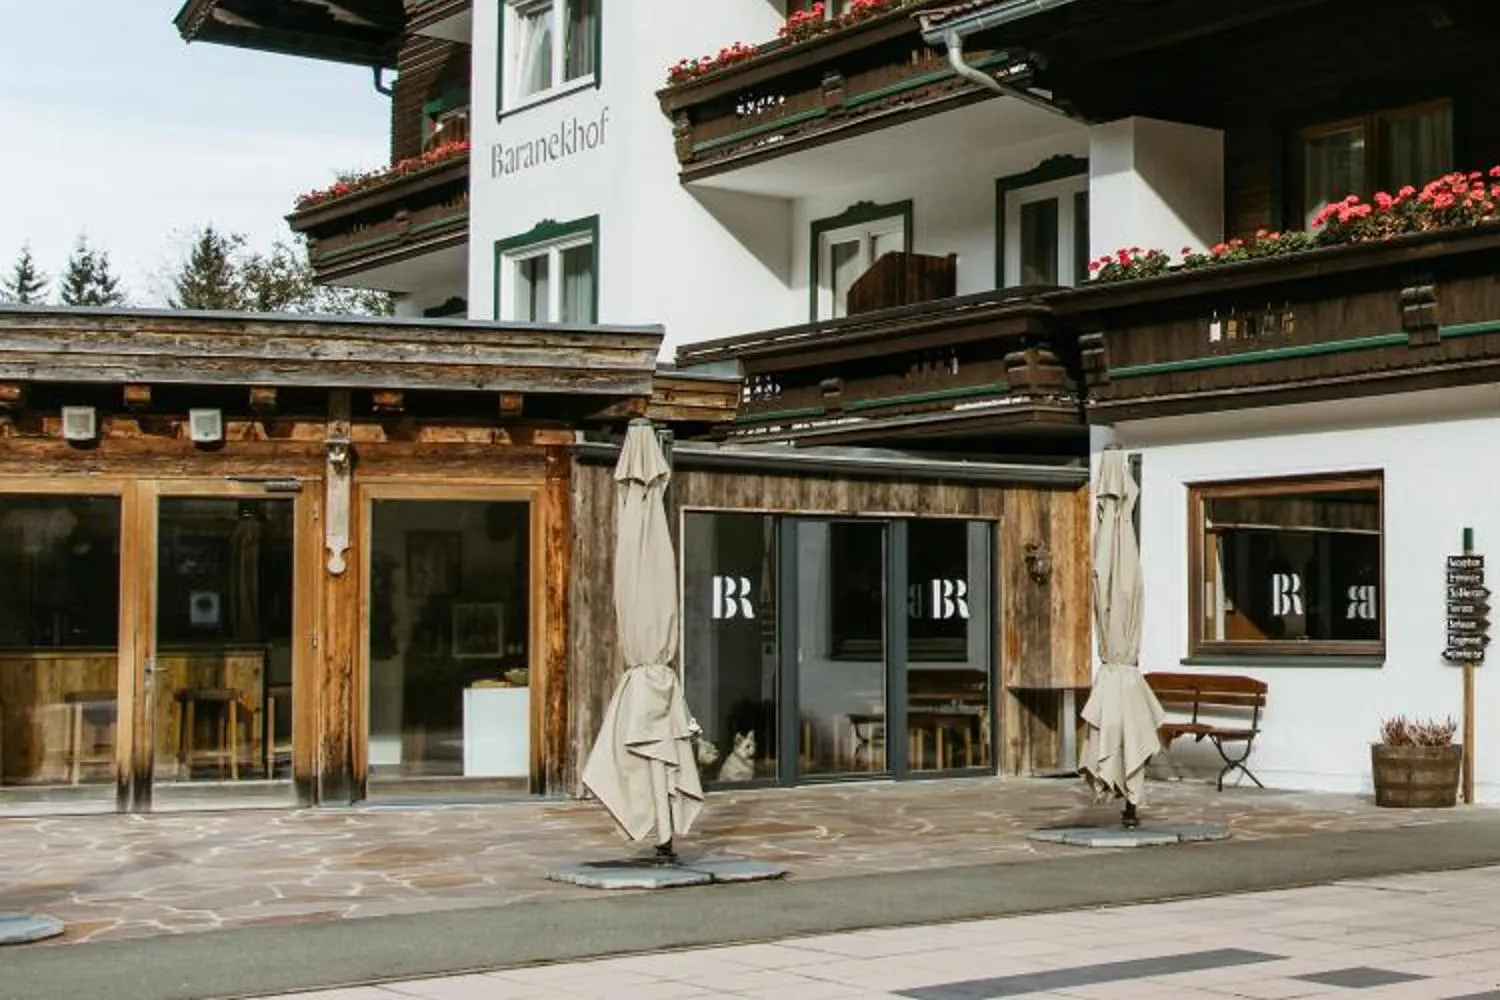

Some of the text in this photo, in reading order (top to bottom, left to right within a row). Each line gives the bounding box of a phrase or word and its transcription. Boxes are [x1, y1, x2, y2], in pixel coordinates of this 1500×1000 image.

[491, 105, 609, 178] Baranekhof
[712, 576, 755, 619] BR
[932, 579, 970, 619] BR
[1273, 573, 1304, 616] BR
